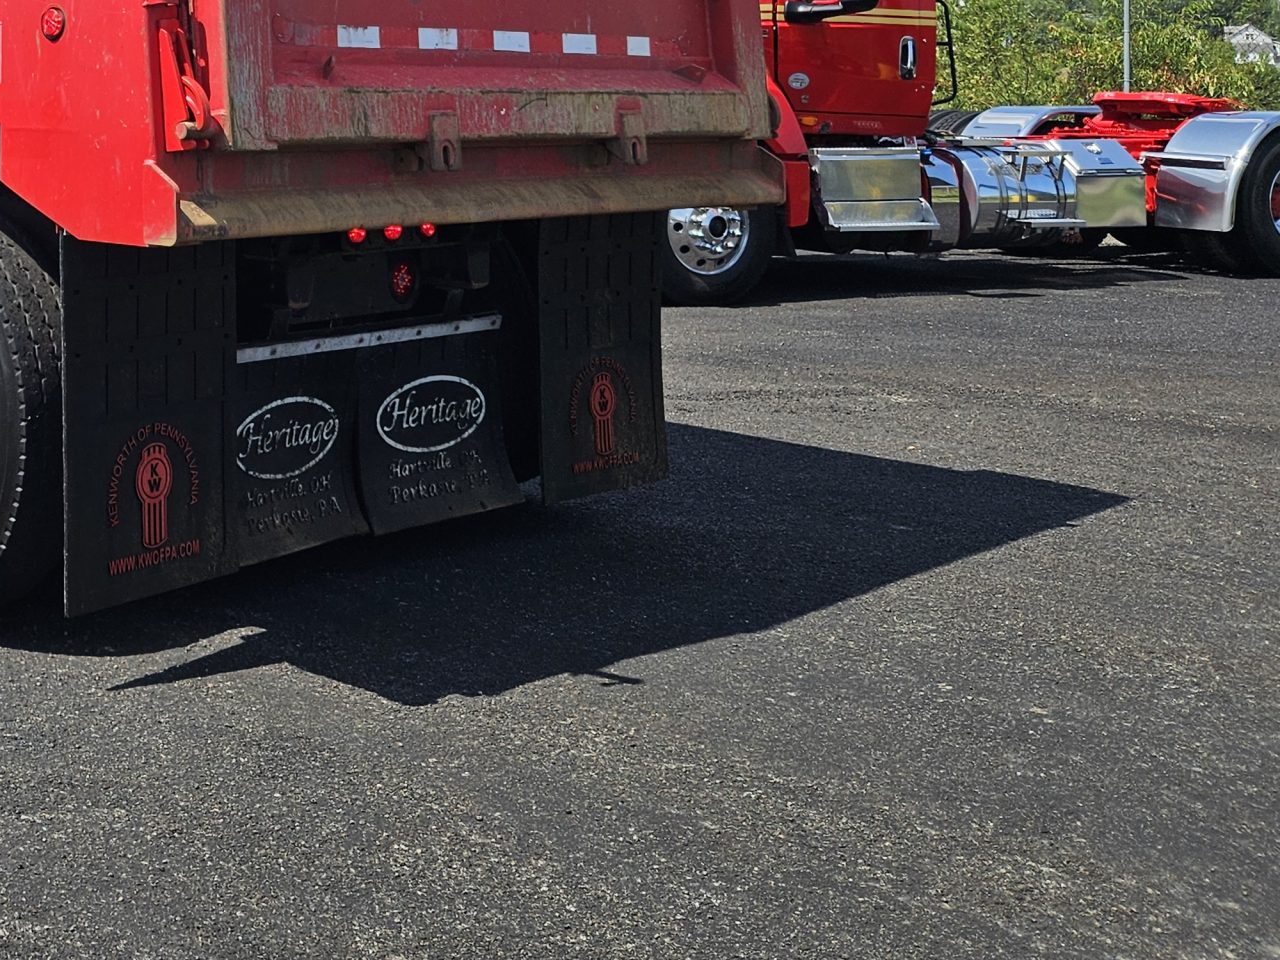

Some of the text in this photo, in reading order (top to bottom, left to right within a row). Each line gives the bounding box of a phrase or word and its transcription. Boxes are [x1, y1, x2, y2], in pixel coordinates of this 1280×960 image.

[383, 390, 481, 431] Heritage
[239, 414, 334, 458] Heritage
[108, 422, 200, 527] KENWORTH OF PENNSYLVANIA
[108, 539, 200, 576] WWW.KWOFPA.COM
